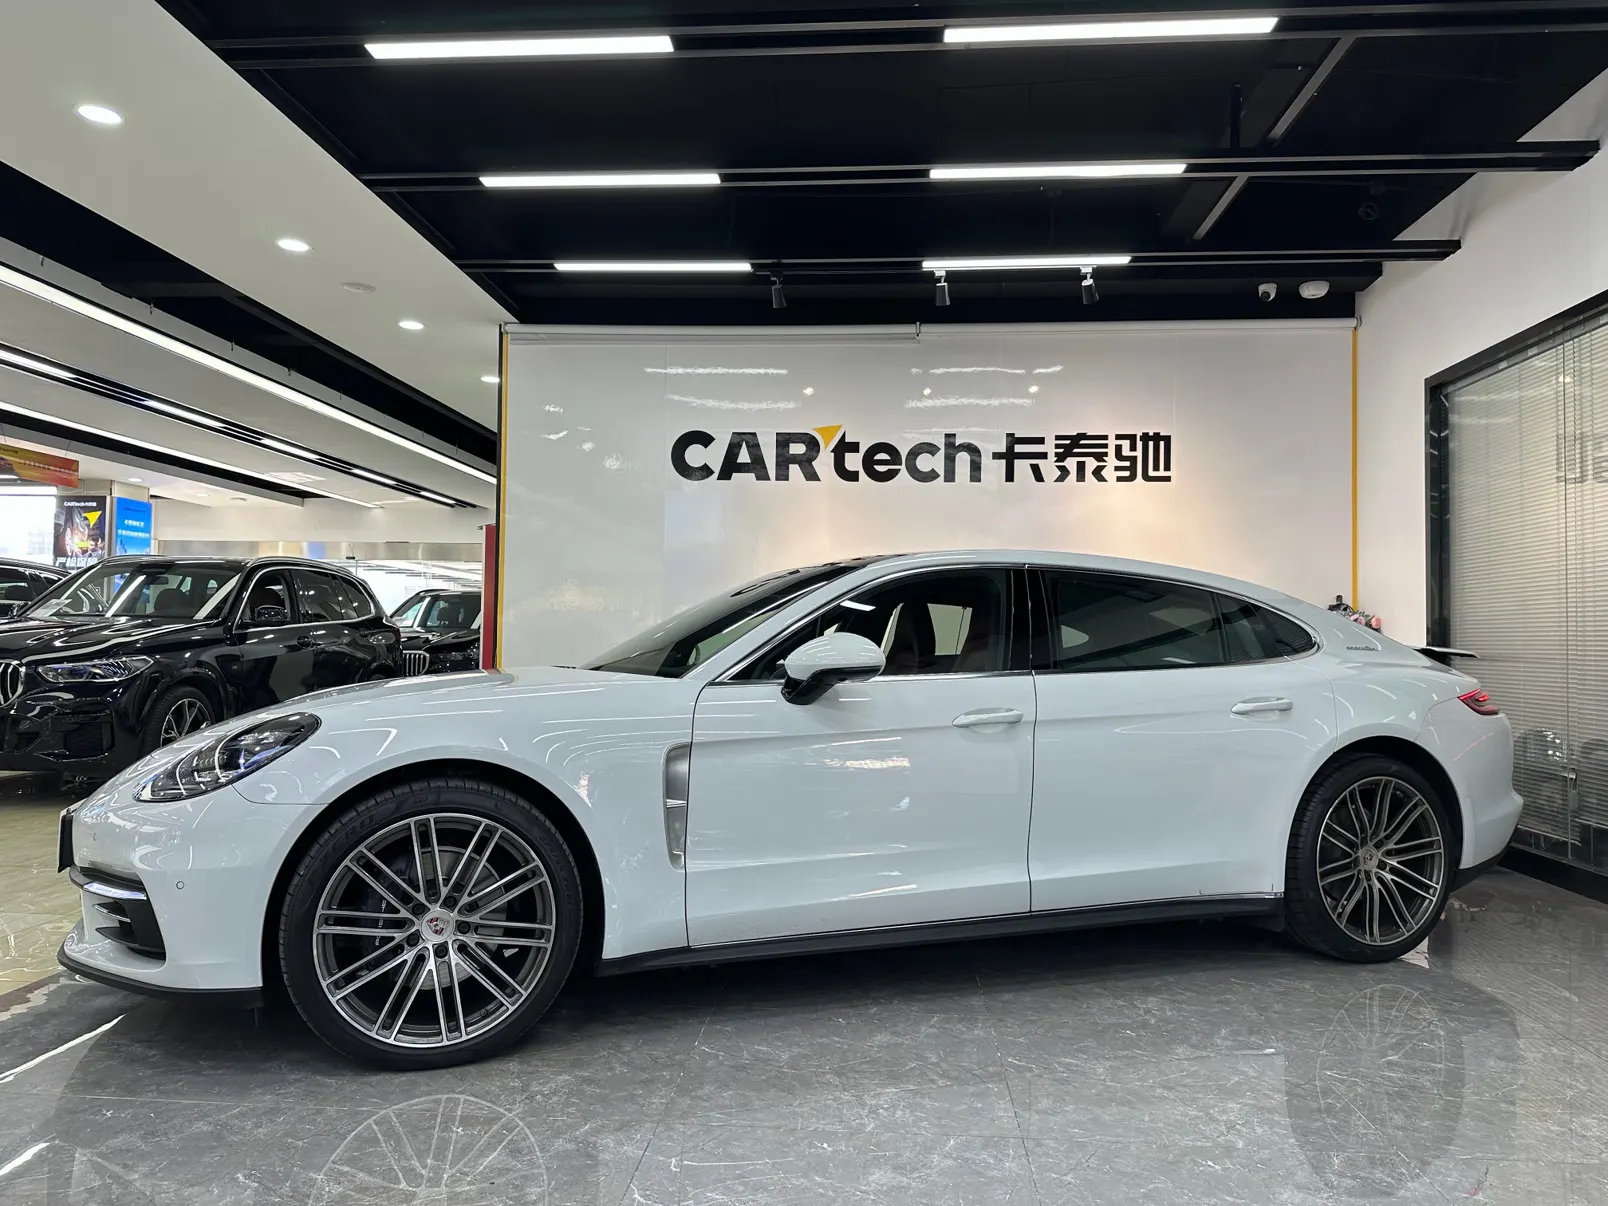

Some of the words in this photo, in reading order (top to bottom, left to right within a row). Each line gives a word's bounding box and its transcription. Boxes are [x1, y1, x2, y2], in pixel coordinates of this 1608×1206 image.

[670, 430, 982, 483] CARtech
[992, 432, 1172, 484] 卡泰驰
